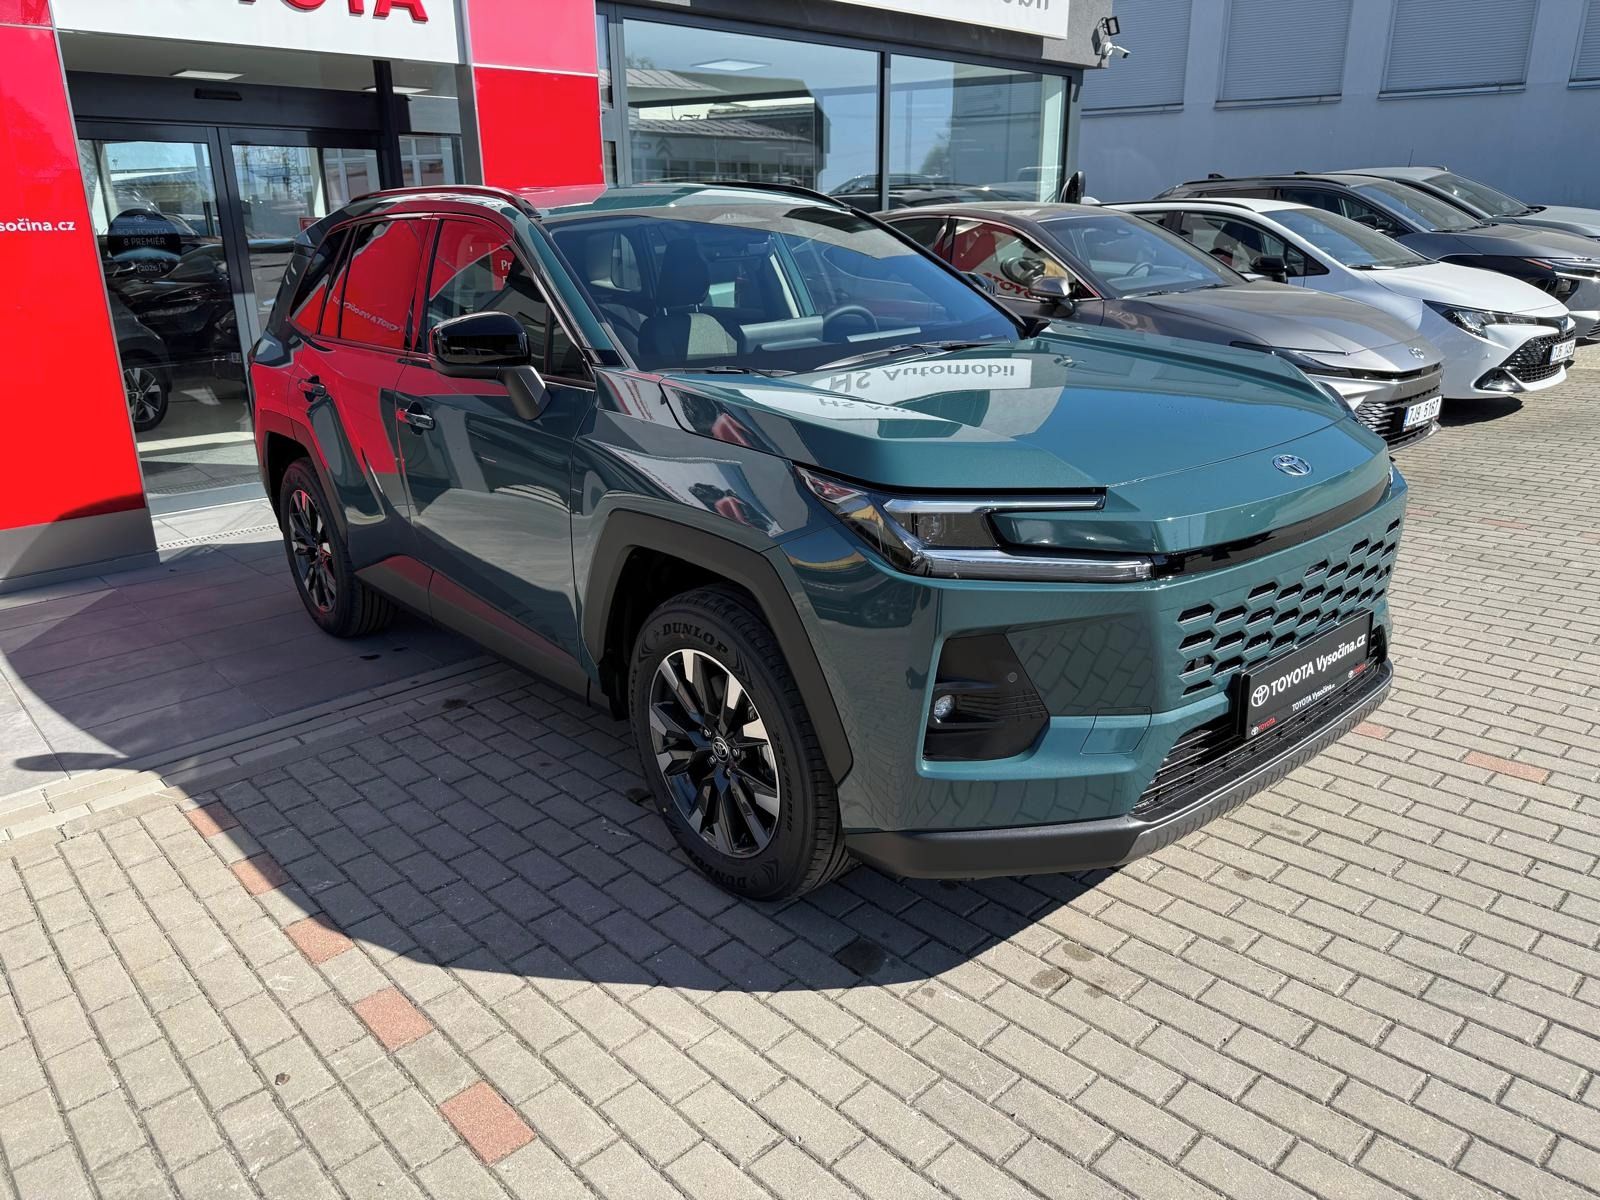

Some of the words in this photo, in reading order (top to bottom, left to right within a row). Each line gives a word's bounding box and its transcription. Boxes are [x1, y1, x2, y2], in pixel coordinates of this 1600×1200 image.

[662, 622, 729, 654] DUNLOP
[1271, 661, 1314, 696] TOYOTA
[1316, 633, 1366, 672] Vysočina.cz
[1292, 697, 1312, 711] TOYOTA
